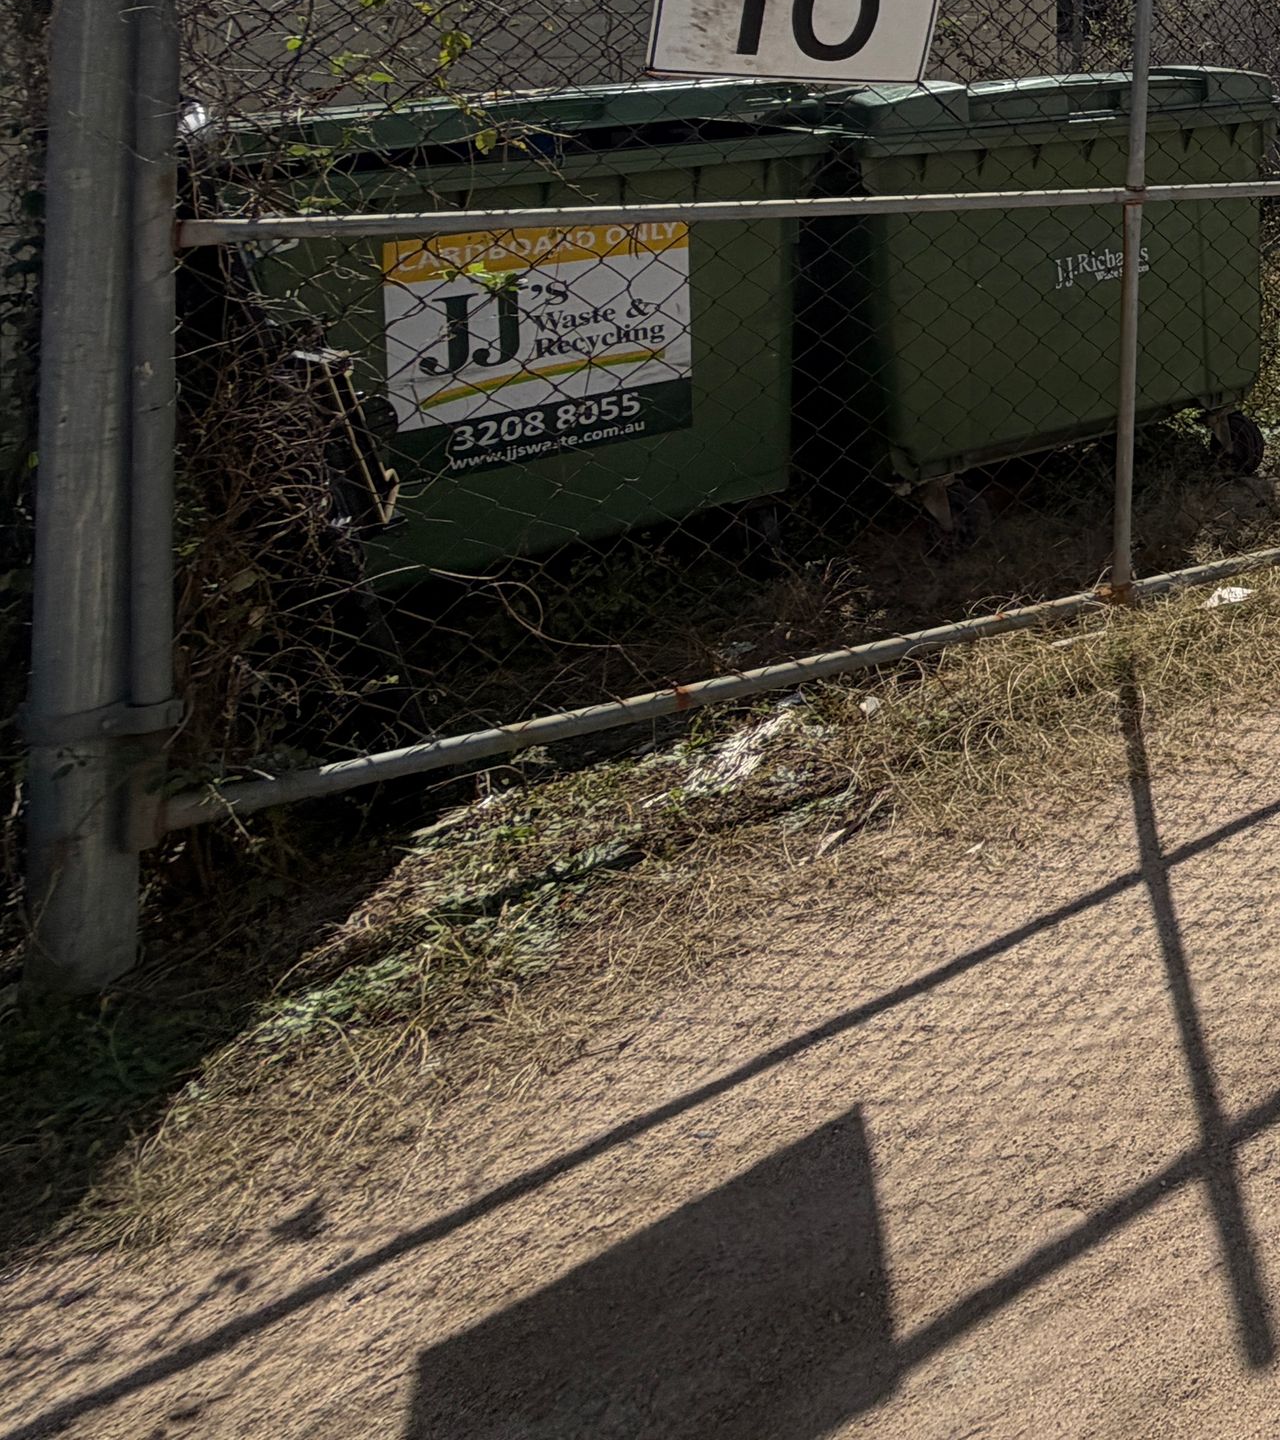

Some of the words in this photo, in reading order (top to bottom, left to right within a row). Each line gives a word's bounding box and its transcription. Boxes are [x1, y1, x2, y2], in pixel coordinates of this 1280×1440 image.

[606, 222, 679, 246] ONLY
[533, 306, 616, 333] Waste
[626, 297, 651, 319] &
[535, 322, 666, 359] Recycling
[453, 411, 546, 451] 3208
[556, 392, 641, 431] 8055
